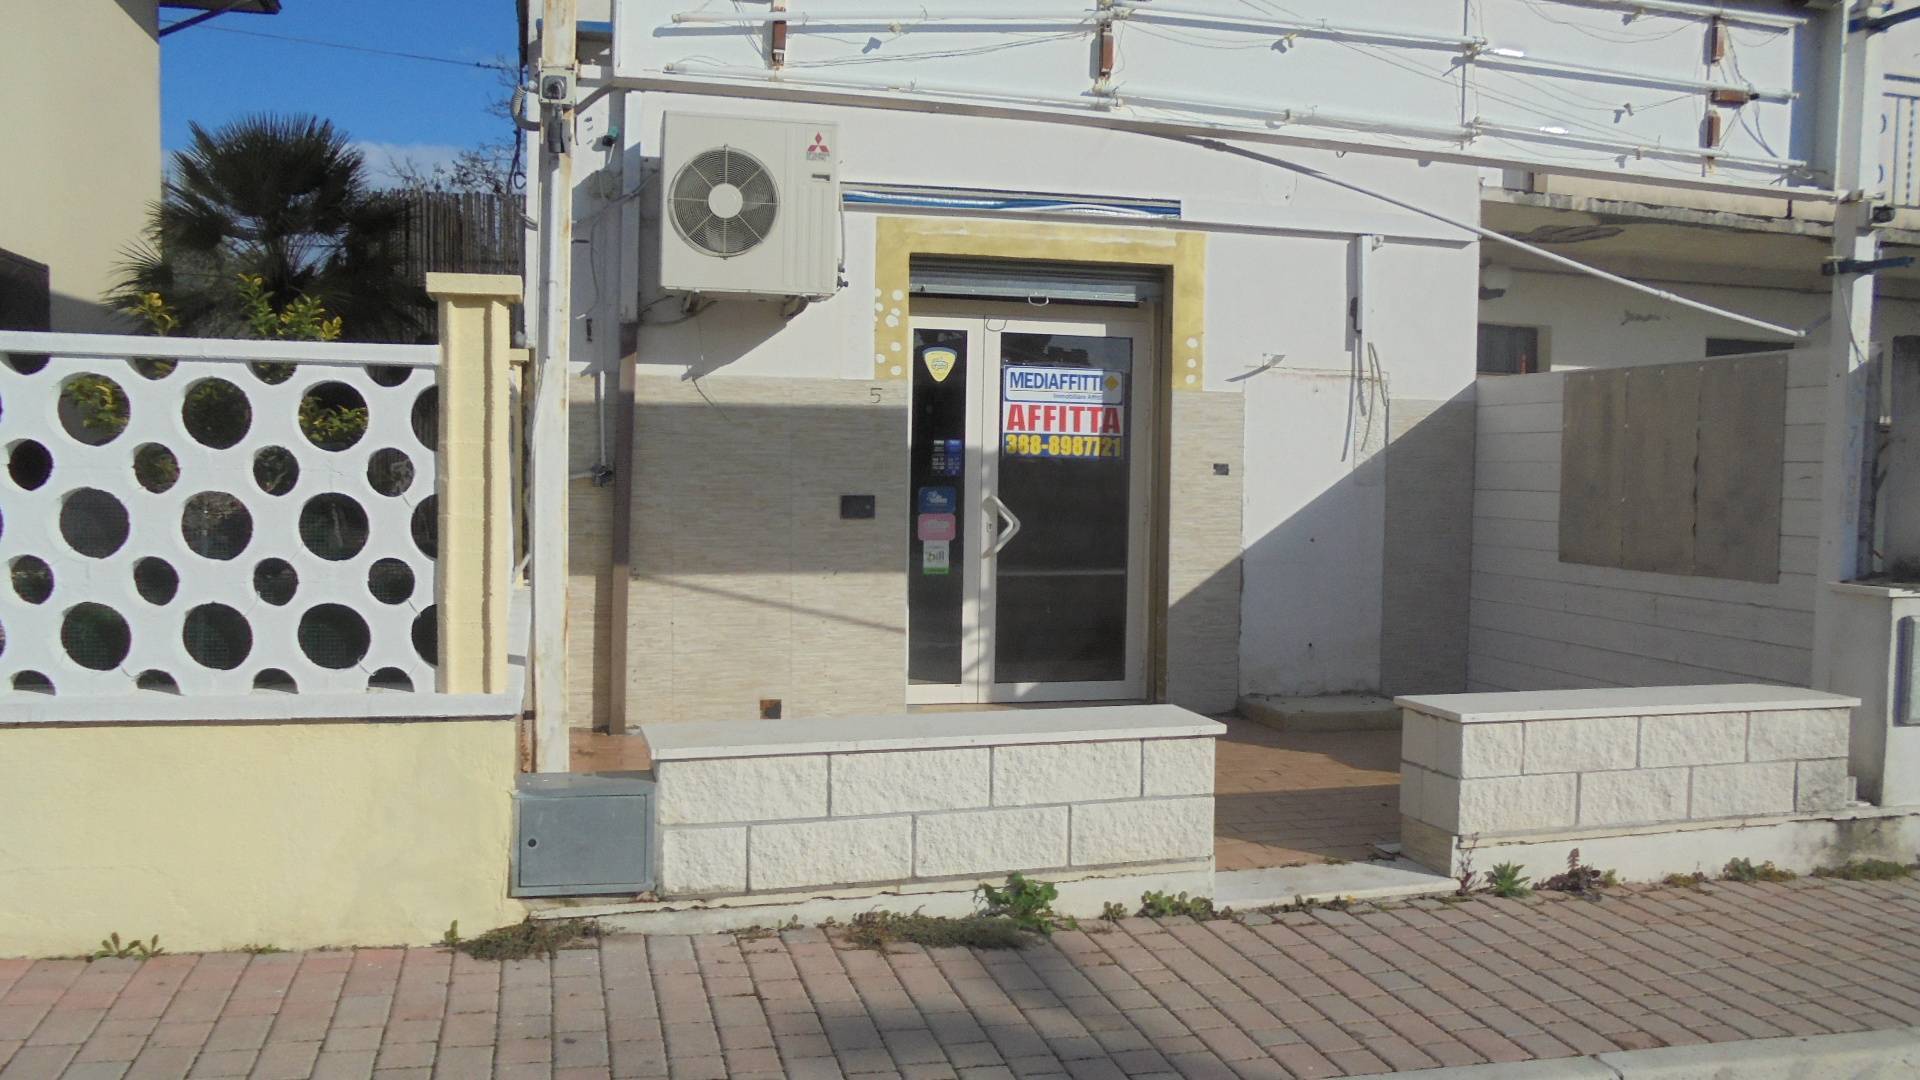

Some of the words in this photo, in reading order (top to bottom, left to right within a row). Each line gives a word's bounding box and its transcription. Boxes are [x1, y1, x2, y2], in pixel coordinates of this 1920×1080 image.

[1009, 371, 1104, 391] MEDIAFFITTI
[869, 387, 883, 404] 5
[1006, 404, 1121, 433] AFFITTA
